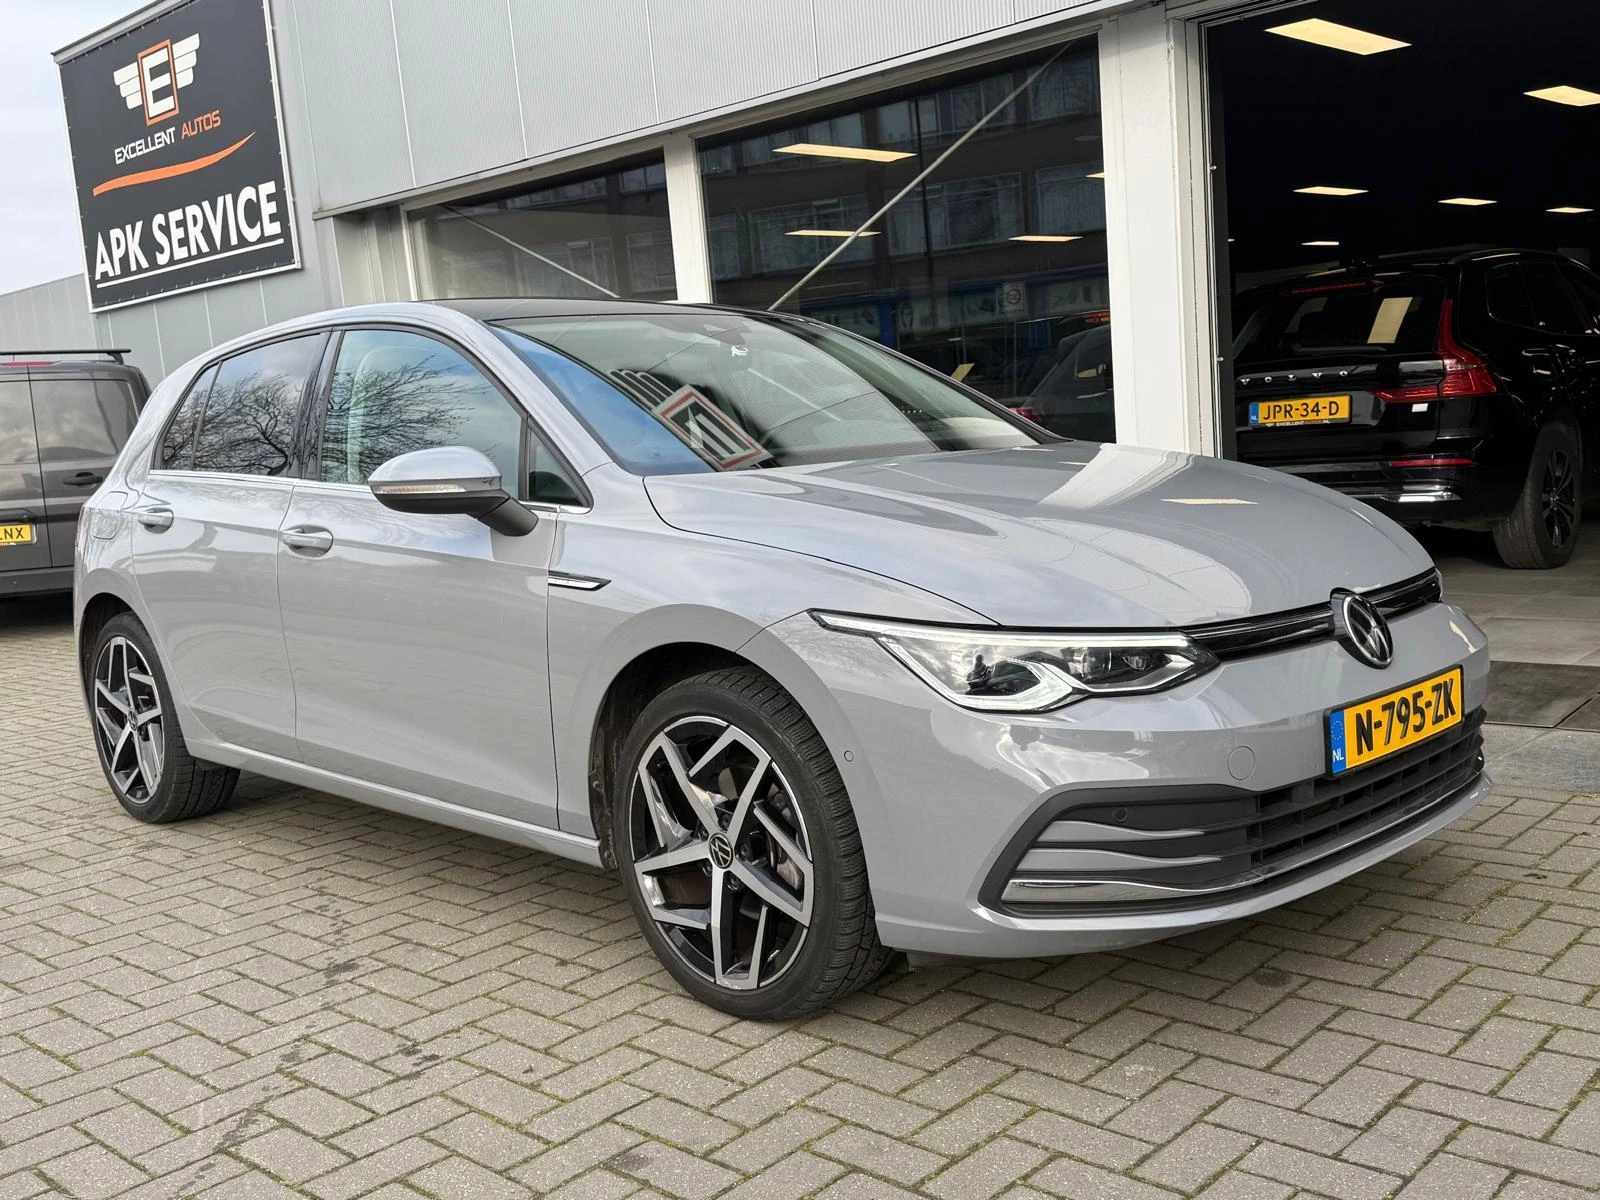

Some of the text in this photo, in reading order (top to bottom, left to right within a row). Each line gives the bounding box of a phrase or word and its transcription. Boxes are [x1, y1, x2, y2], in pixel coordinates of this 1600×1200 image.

[114, 109, 221, 165] EXCELLENT AUTOS
[94, 180, 282, 281] APK SERVICE
[1240, 370, 1348, 385] VOLVO
[1263, 401, 1340, 420] JPR-34-D
[1355, 677, 1457, 756] N-795-ZK
[1332, 748, 1345, 762] NL
